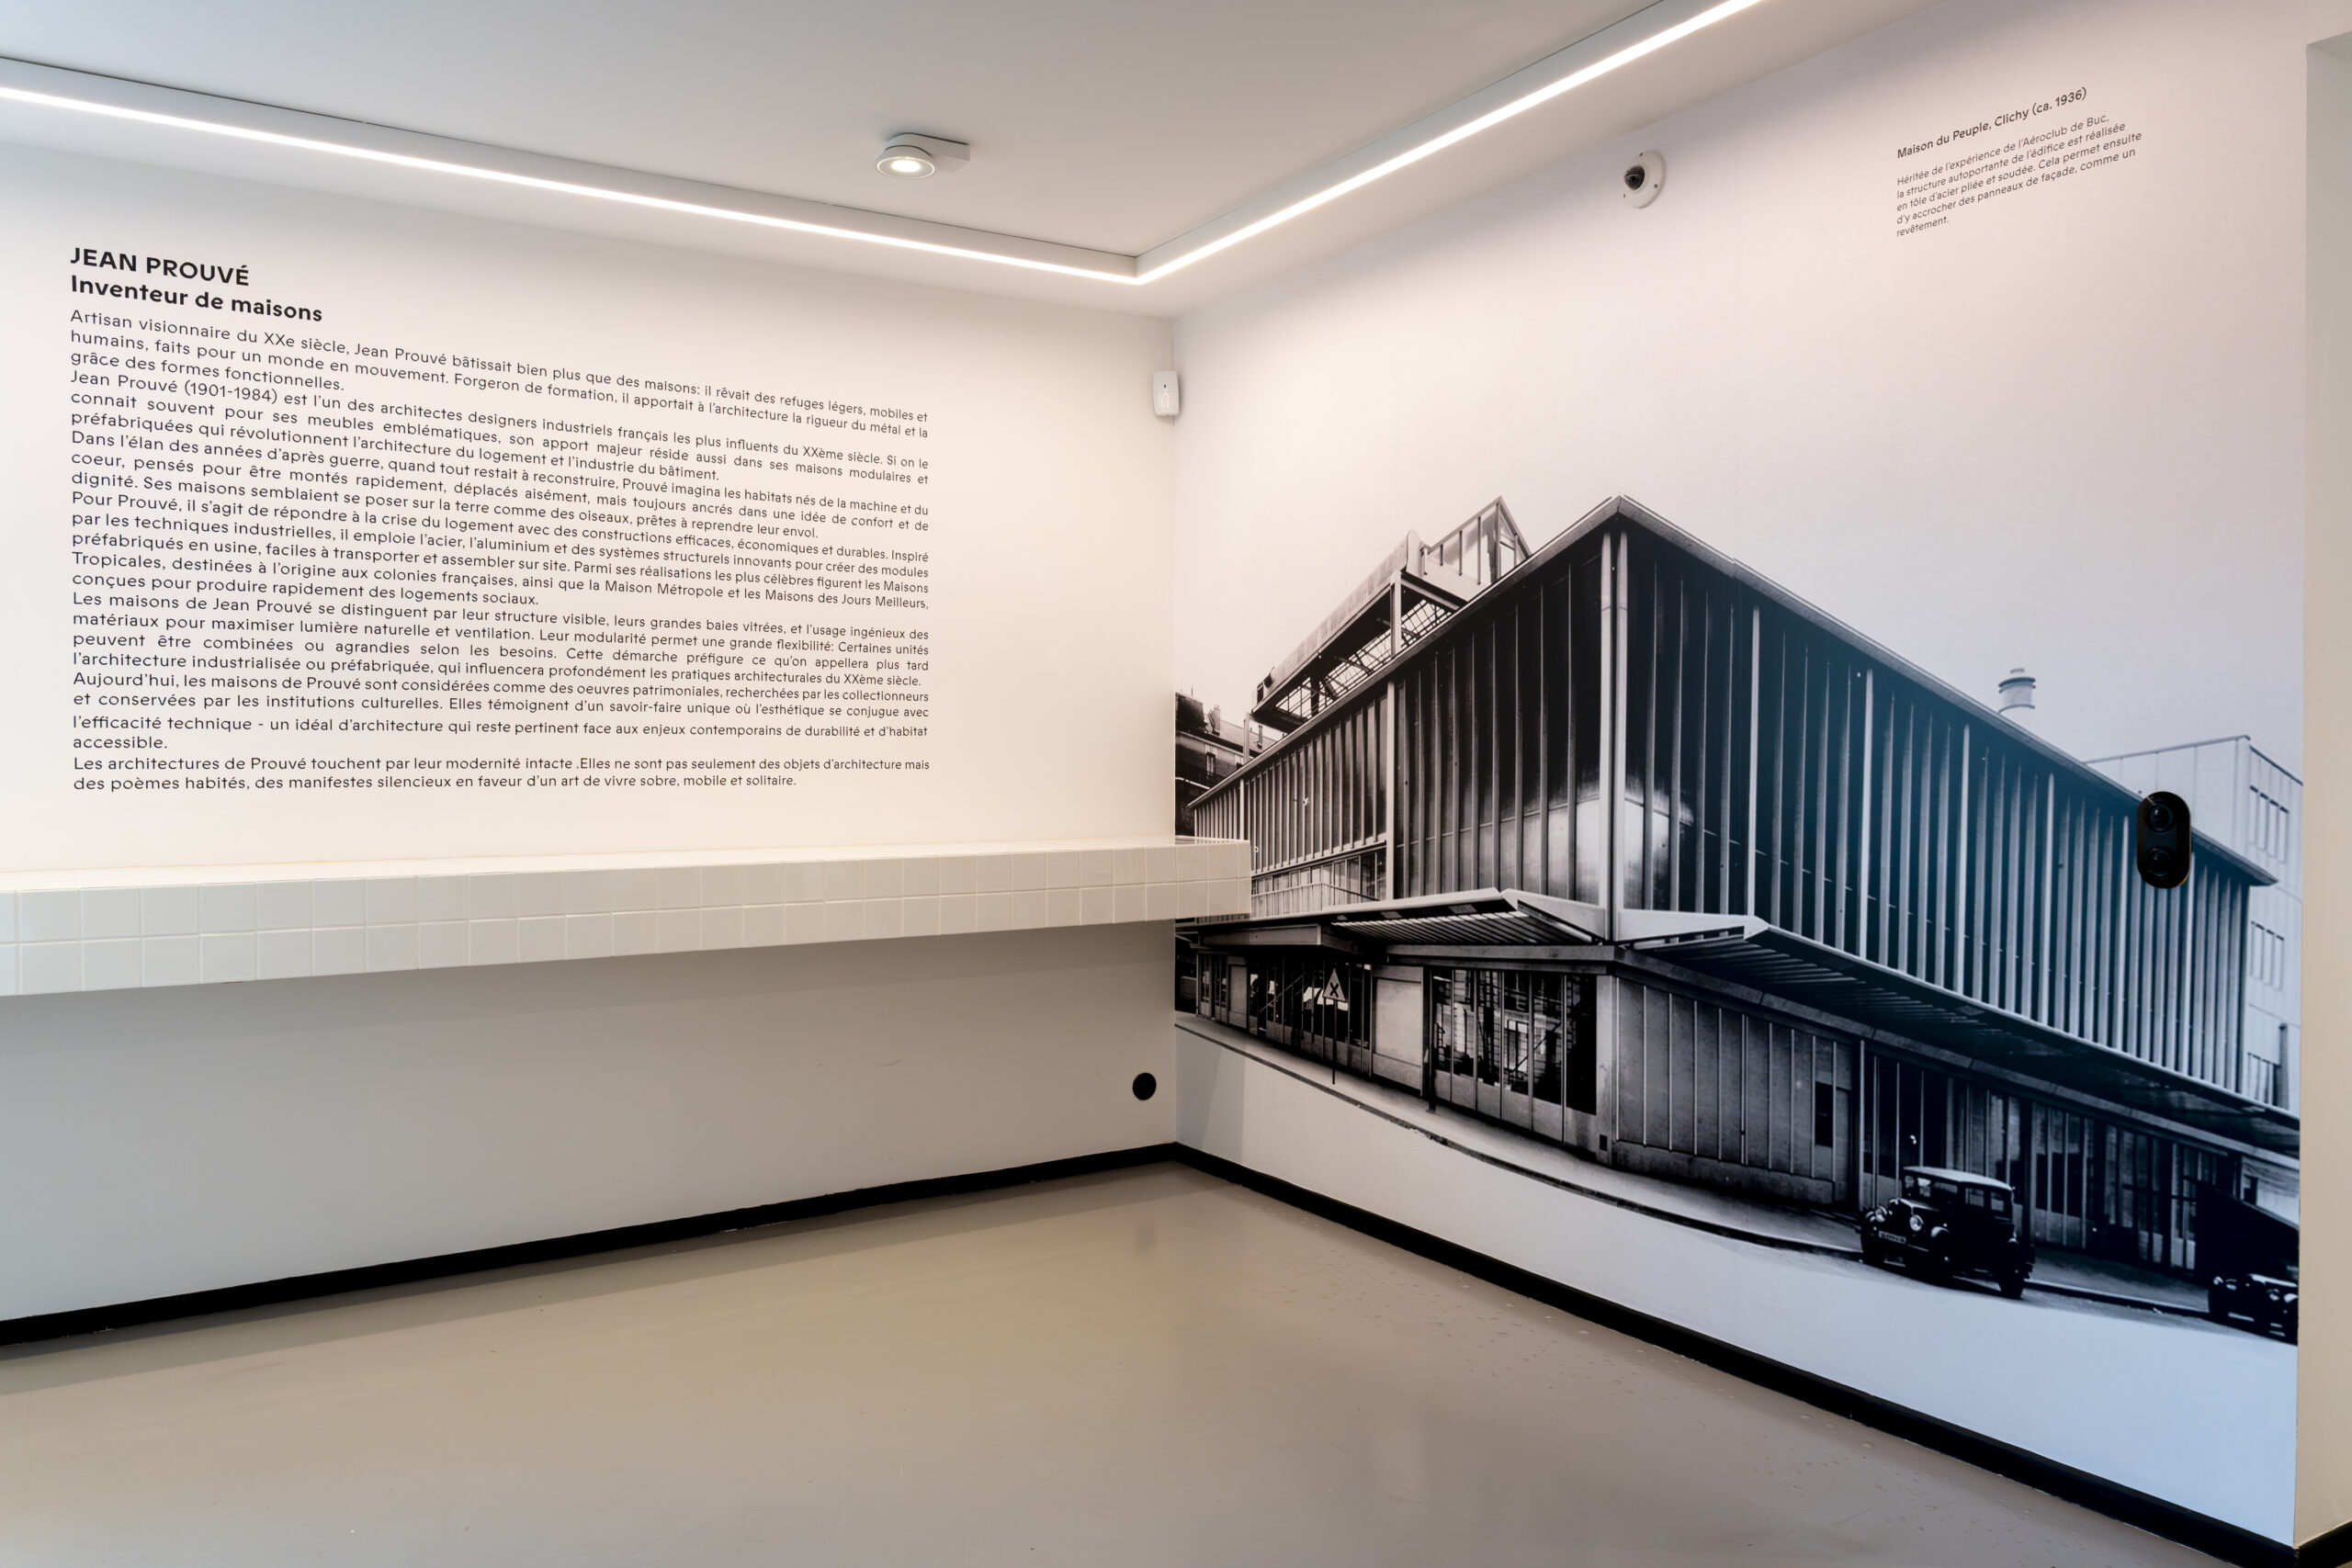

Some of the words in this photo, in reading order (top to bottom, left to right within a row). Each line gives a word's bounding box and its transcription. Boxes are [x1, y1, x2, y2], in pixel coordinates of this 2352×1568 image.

[1896, 140, 1935, 160] Maison
[1935, 133, 1951, 147] du
[1951, 120, 1993, 142] Peuple,
[1993, 107, 2030, 128] Clichy
[2030, 101, 2053, 118] (ca.
[2053, 85, 2088, 108] 1936)
[1896, 169, 1930, 187] Héritée
[1929, 164, 1945, 176] de
[2002, 141, 2018, 154] de
[2069, 120, 2086, 133] de
[2086, 114, 2110, 129] Buc,
[1895, 189, 1905, 200] la
[1905, 177, 1948, 197] structure
[1947, 158, 2010, 185] autoportante
[2010, 152, 2025, 165] de
[2066, 133, 2085, 148] est
[2084, 122, 2127, 143] réalisée
[1895, 201, 1909, 213] en
[1908, 195, 1928, 209] tôle
[1960, 178, 1985, 196] pliée
[1984, 174, 1997, 186] et
[1996, 164, 2037, 183] soudée.
[2037, 155, 2061, 171] Cela
[2062, 142, 2102, 166] permet
[2101, 131, 2143, 152] ensuite
[1911, 199, 1958, 221] accrocher
[1957, 195, 1976, 208] des
[1976, 180, 2025, 204] panneaux
[2024, 175, 2040, 188] de
[2040, 164, 2079, 184] façade,
[2078, 152, 2120, 173] comme
[2120, 148, 2137, 160] un
[1895, 214, 1950, 239] revêtement.
[69, 246, 138, 274] JEAN
[145, 255, 250, 288] PROUVÉ
[71, 273, 190, 307] Inventeur
[194, 290, 225, 311] de
[230, 298, 323, 323] maisons
[69, 309, 133, 330] Artisan
[137, 318, 232, 341] visionnaire
[235, 328, 258, 344] du
[263, 331, 296, 349] XXe
[300, 336, 351, 356] siècle,
[353, 342, 390, 360] Jean
[394, 346, 448, 367] Prouvé
[451, 354, 513, 374] bâtissait
[515, 361, 548, 378] bien
[551, 367, 582, 382] plus
[584, 372, 613, 387] que
[615, 374, 640, 389] des
[643, 379, 701, 396] maisons:
[704, 384, 712, 398] il
[715, 386, 752, 402] rêvait
[752, 390, 776, 405] des
[779, 395, 825, 412] refuges
[827, 399, 867, 417] légers,
[868, 406, 915, 422] mobiles
[915, 412, 929, 423] et
[69, 368, 111, 388] Jean
[117, 373, 179, 394] Prouvé
[183, 378, 278, 406] (1901-1984)
[283, 393, 309, 407] est
[312, 393, 342, 411] l’un
[346, 398, 376, 413] des
[379, 402, 464, 423] architectes
[467, 410, 538, 430] designers
[541, 417, 614, 437] industriels
[616, 424, 670, 444] français
[673, 430, 692, 446] les
[695, 434, 722, 448] plus
[725, 436, 780, 455] influents
[782, 443, 799, 457] du
[801, 445, 845, 461] XXème
[846, 450, 884, 466] siècle.
[886, 454, 898, 467] Si
[899, 457, 916, 468] on
[918, 457, 930, 470] le
[70, 453, 126, 470] coeur,
[133, 457, 195, 474] pensés
[201, 463, 243, 478] pour
[248, 464, 282, 480] être
[288, 469, 349, 486] montés
[355, 474, 447, 495] rapidement,
[452, 480, 519, 499] déplacés
[524, 487, 592, 506] aisément,
[595, 494, 628, 508] mais
[631, 495, 687, 513] toujours
[691, 502, 734, 516] ancrés
[737, 504, 768, 519] dans
[772, 509, 797, 522] une
[799, 509, 828, 525] idée
[831, 513, 848, 525] de
[850, 515, 895, 529] confort
[897, 518, 910, 531] et
[913, 519, 930, 533] de
[71, 513, 102, 528] par
[105, 512, 130, 528] les
[132, 514, 230, 536] techniques
[232, 521, 337, 543] industrielles,
[339, 527, 349, 542] il
[352, 530, 417, 547] emploie
[419, 532, 467, 550] l’acier,
[469, 536, 551, 554] l’aluminium
[553, 542, 570, 555] et
[570, 542, 596, 558] des
[598, 546, 661, 561] systèmes
[662, 549, 731, 566] structurels
[732, 553, 793, 570] innovants
[794, 559, 824, 572] pour
[824, 560, 856, 574] créer
[856, 561, 879, 576] des
[880, 565, 930, 580] modules
[72, 612, 160, 628] matériaux
[164, 617, 207, 630] pour
[210, 617, 296, 633] maximiser
[299, 619, 359, 636] lumière
[363, 622, 431, 637] naturelle
[434, 625, 452, 638] et
[453, 626, 536, 641] ventilation.
[538, 627, 571, 643] Leur
[573, 630, 648, 646] modularité
[650, 635, 699, 649] permet
[701, 637, 727, 649] une
[728, 637, 774, 651] grande
[775, 637, 835, 653] flexibilité:
[837, 640, 893, 655] Certaines
[894, 643, 930, 657] unités
[73, 756, 104, 772] Les
[107, 756, 220, 771] architectures
[223, 756, 247, 771] de
[250, 756, 308, 771] Prouvé
[310, 756, 383, 771] touchent
[384, 759, 412, 773] par
[413, 756, 444, 771] leur
[445, 756, 522, 771] modernité
[525, 757, 574, 771] intacte
[613, 759, 632, 771] ne
[633, 757, 664, 771] sont
[664, 760, 689, 773] pas
[690, 757, 757, 771] seulement
[757, 757, 782, 771] des
[782, 758, 821, 773] objets
[822, 757, 903, 771] d’architecture
[904, 759, 931, 771] mais
